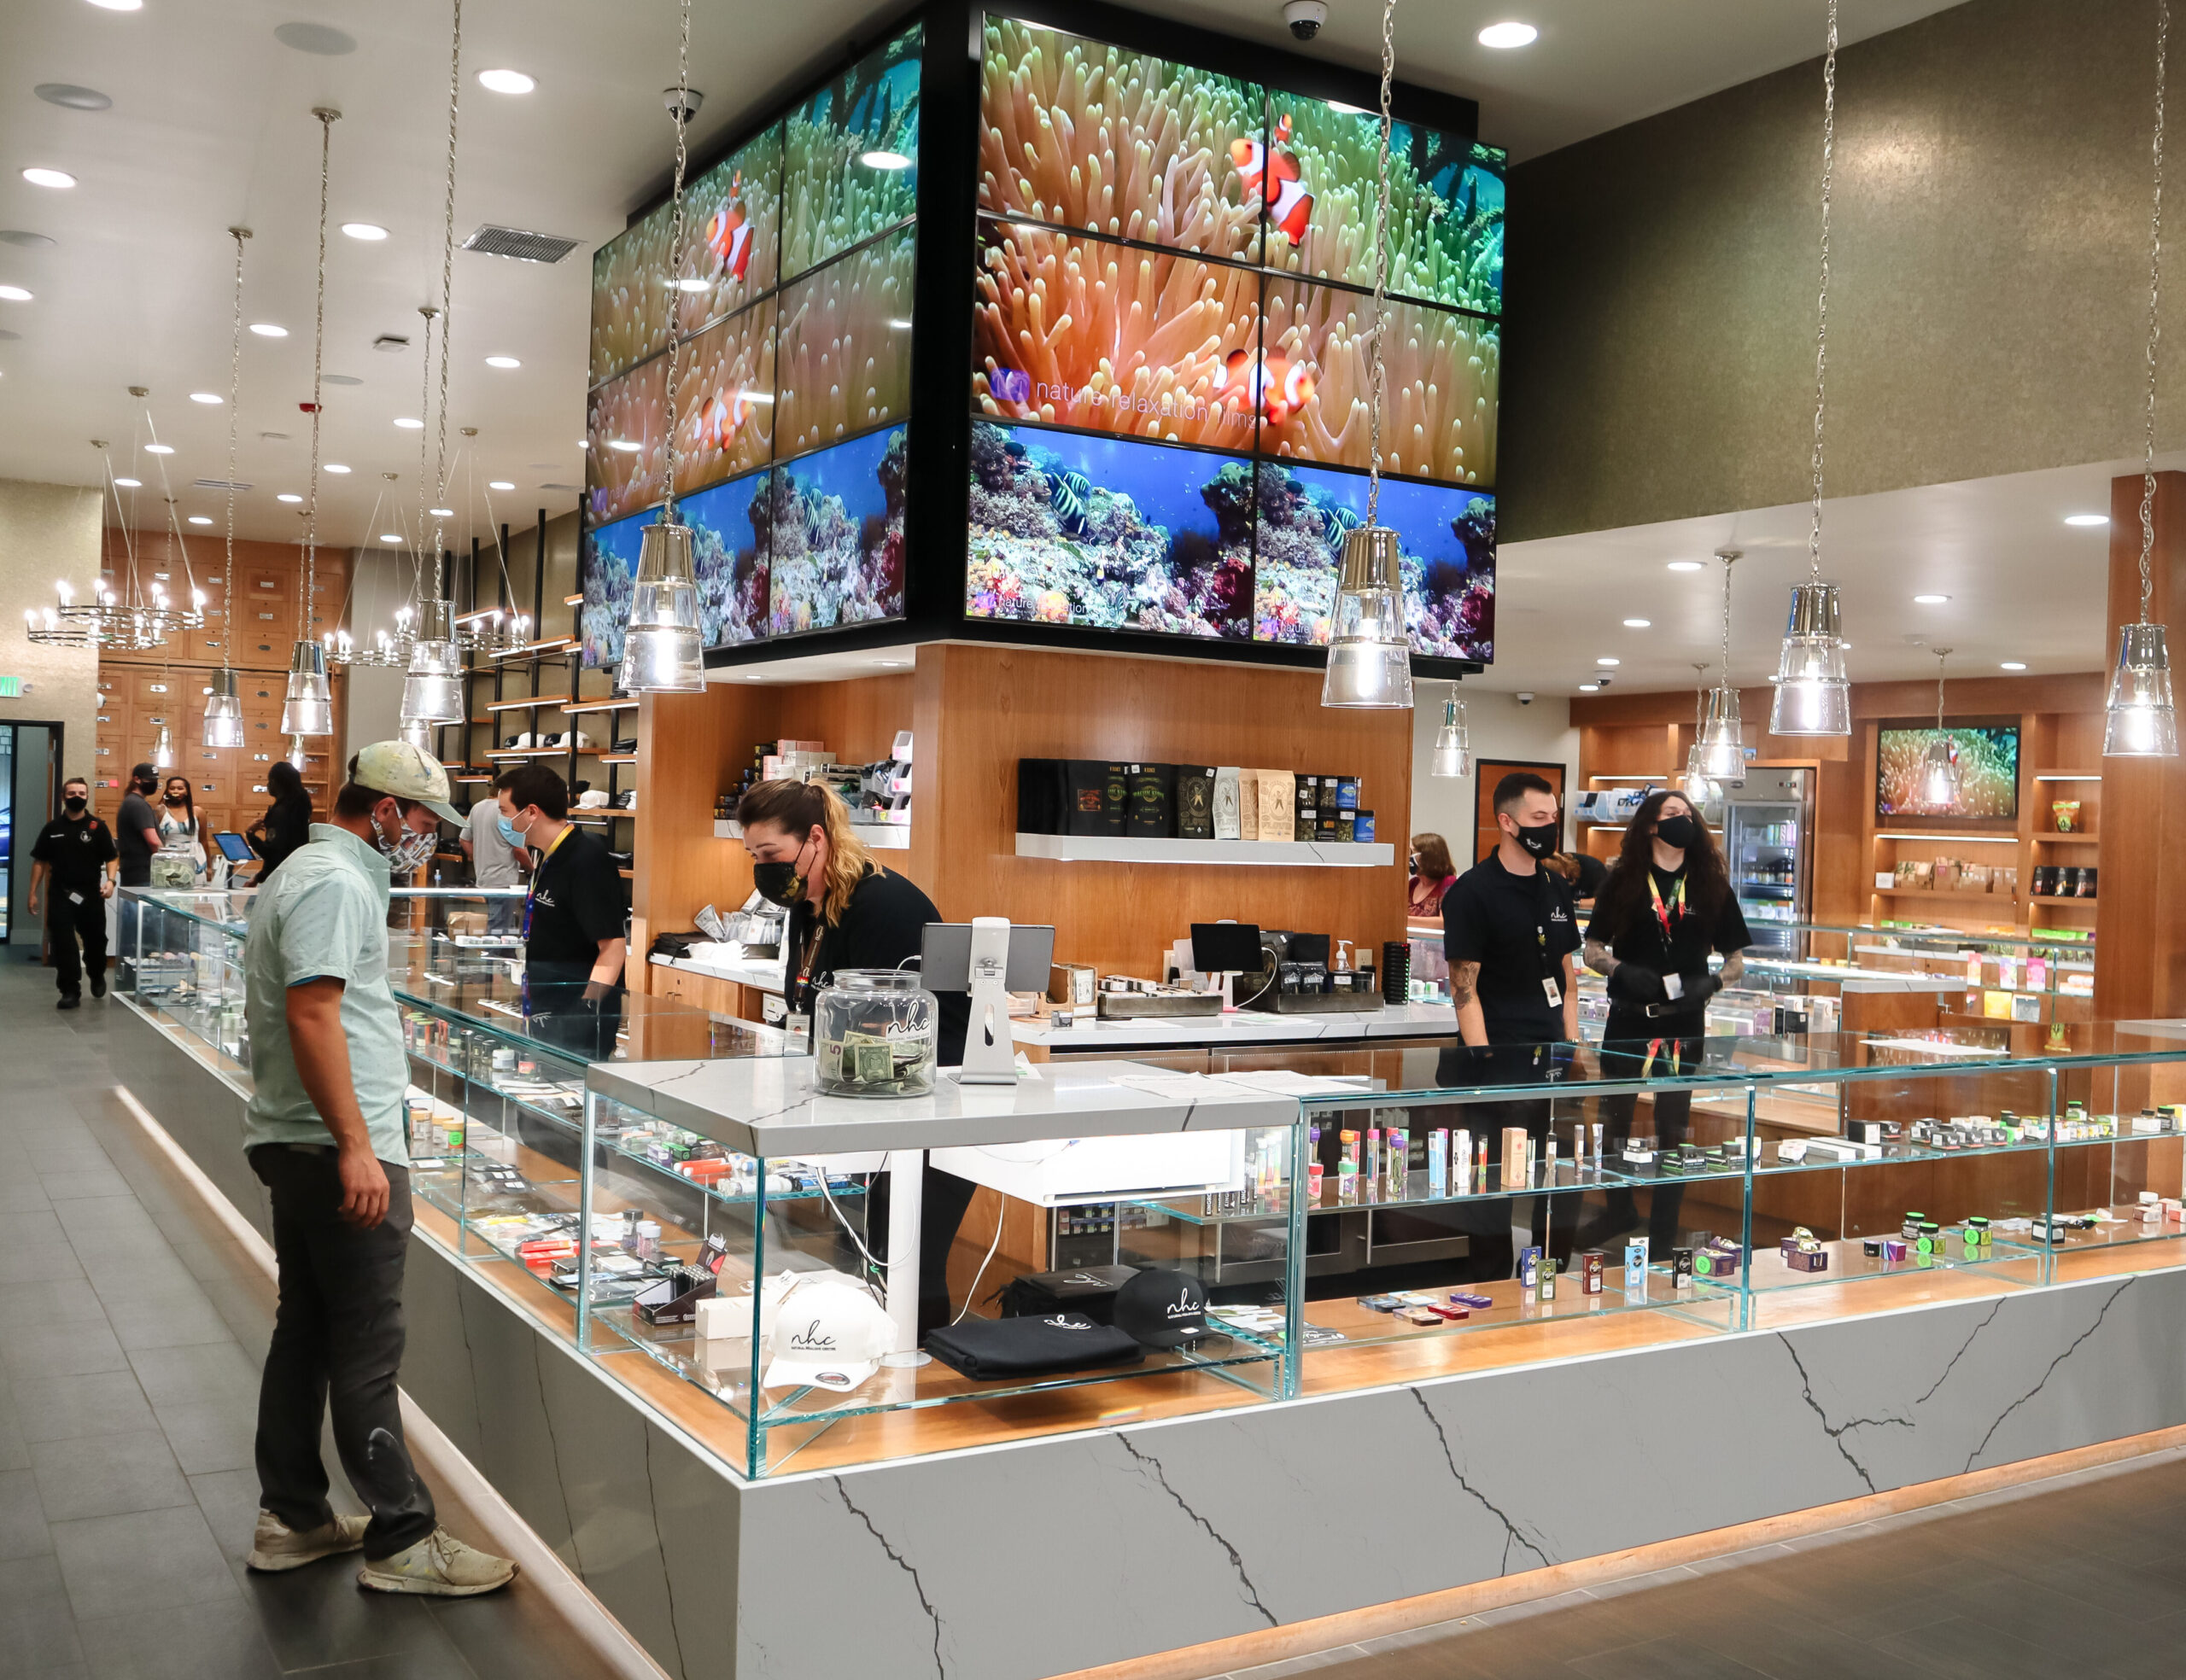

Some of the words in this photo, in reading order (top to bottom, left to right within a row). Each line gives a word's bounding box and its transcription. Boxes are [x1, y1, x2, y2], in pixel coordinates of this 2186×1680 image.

[1036, 381, 1102, 406] nature
[1111, 392, 1209, 423] relaxation
[536, 890, 554, 903] nhc
[1551, 906, 1567, 919] nhc
[812, 971, 832, 989] nhc
[887, 1001, 930, 1034] nhc
[1166, 1287, 1200, 1314] nhc
[791, 1320, 836, 1345] nhc
